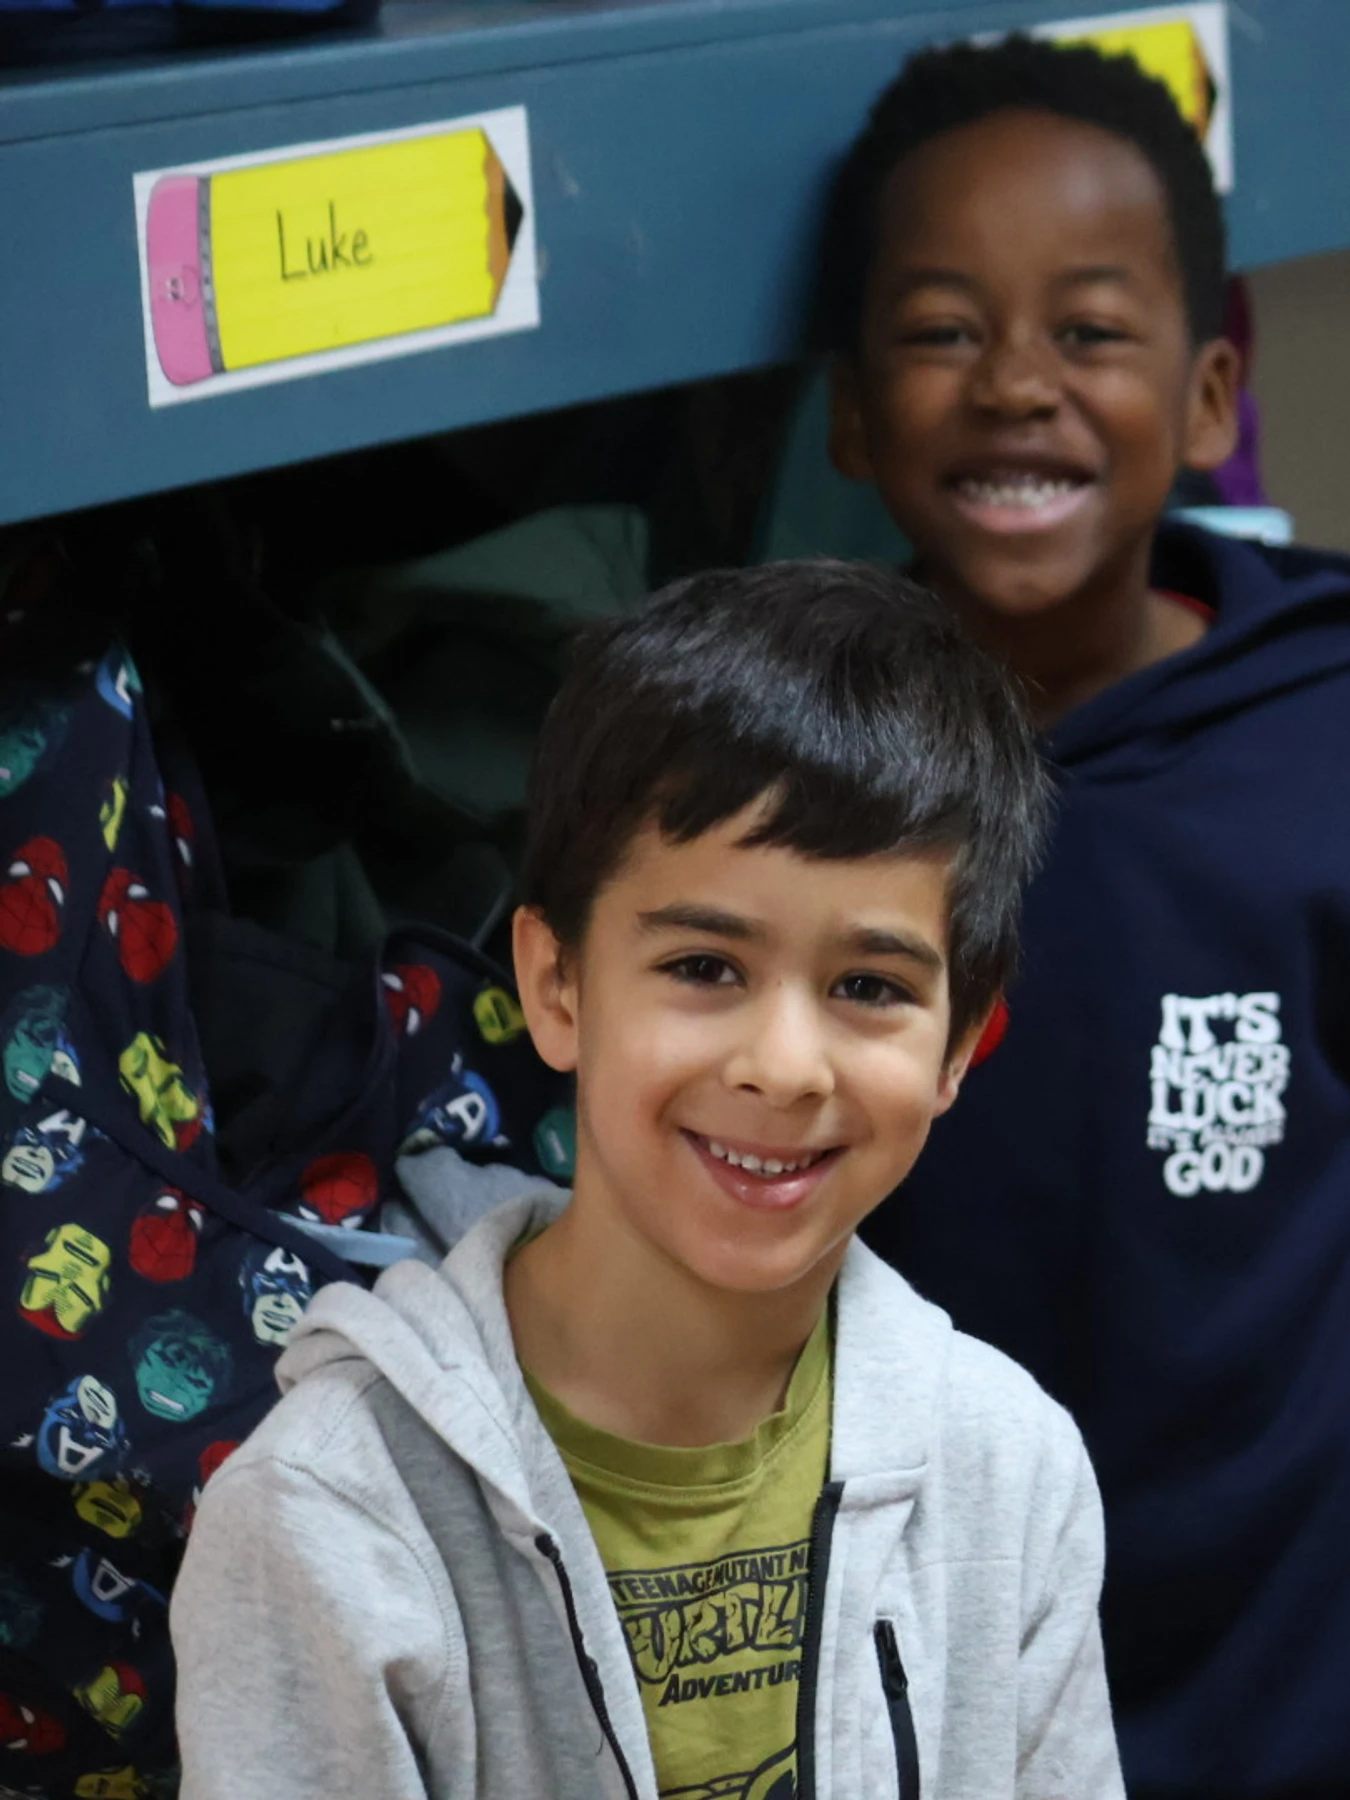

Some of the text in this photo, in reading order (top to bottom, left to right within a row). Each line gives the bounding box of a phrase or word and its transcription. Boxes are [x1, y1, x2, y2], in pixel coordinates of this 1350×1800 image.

[276, 199, 376, 282] Luke
[1159, 992, 1282, 1053] IT'S
[1150, 1042, 1291, 1090] NEVER
[1148, 1080, 1287, 1131] LUCK
[1163, 1142, 1265, 1197] GOD
[609, 1569, 712, 1602] TEENAGE
[711, 1552, 788, 1589] MUTANT
[657, 1659, 802, 1707] ADVENTUR
